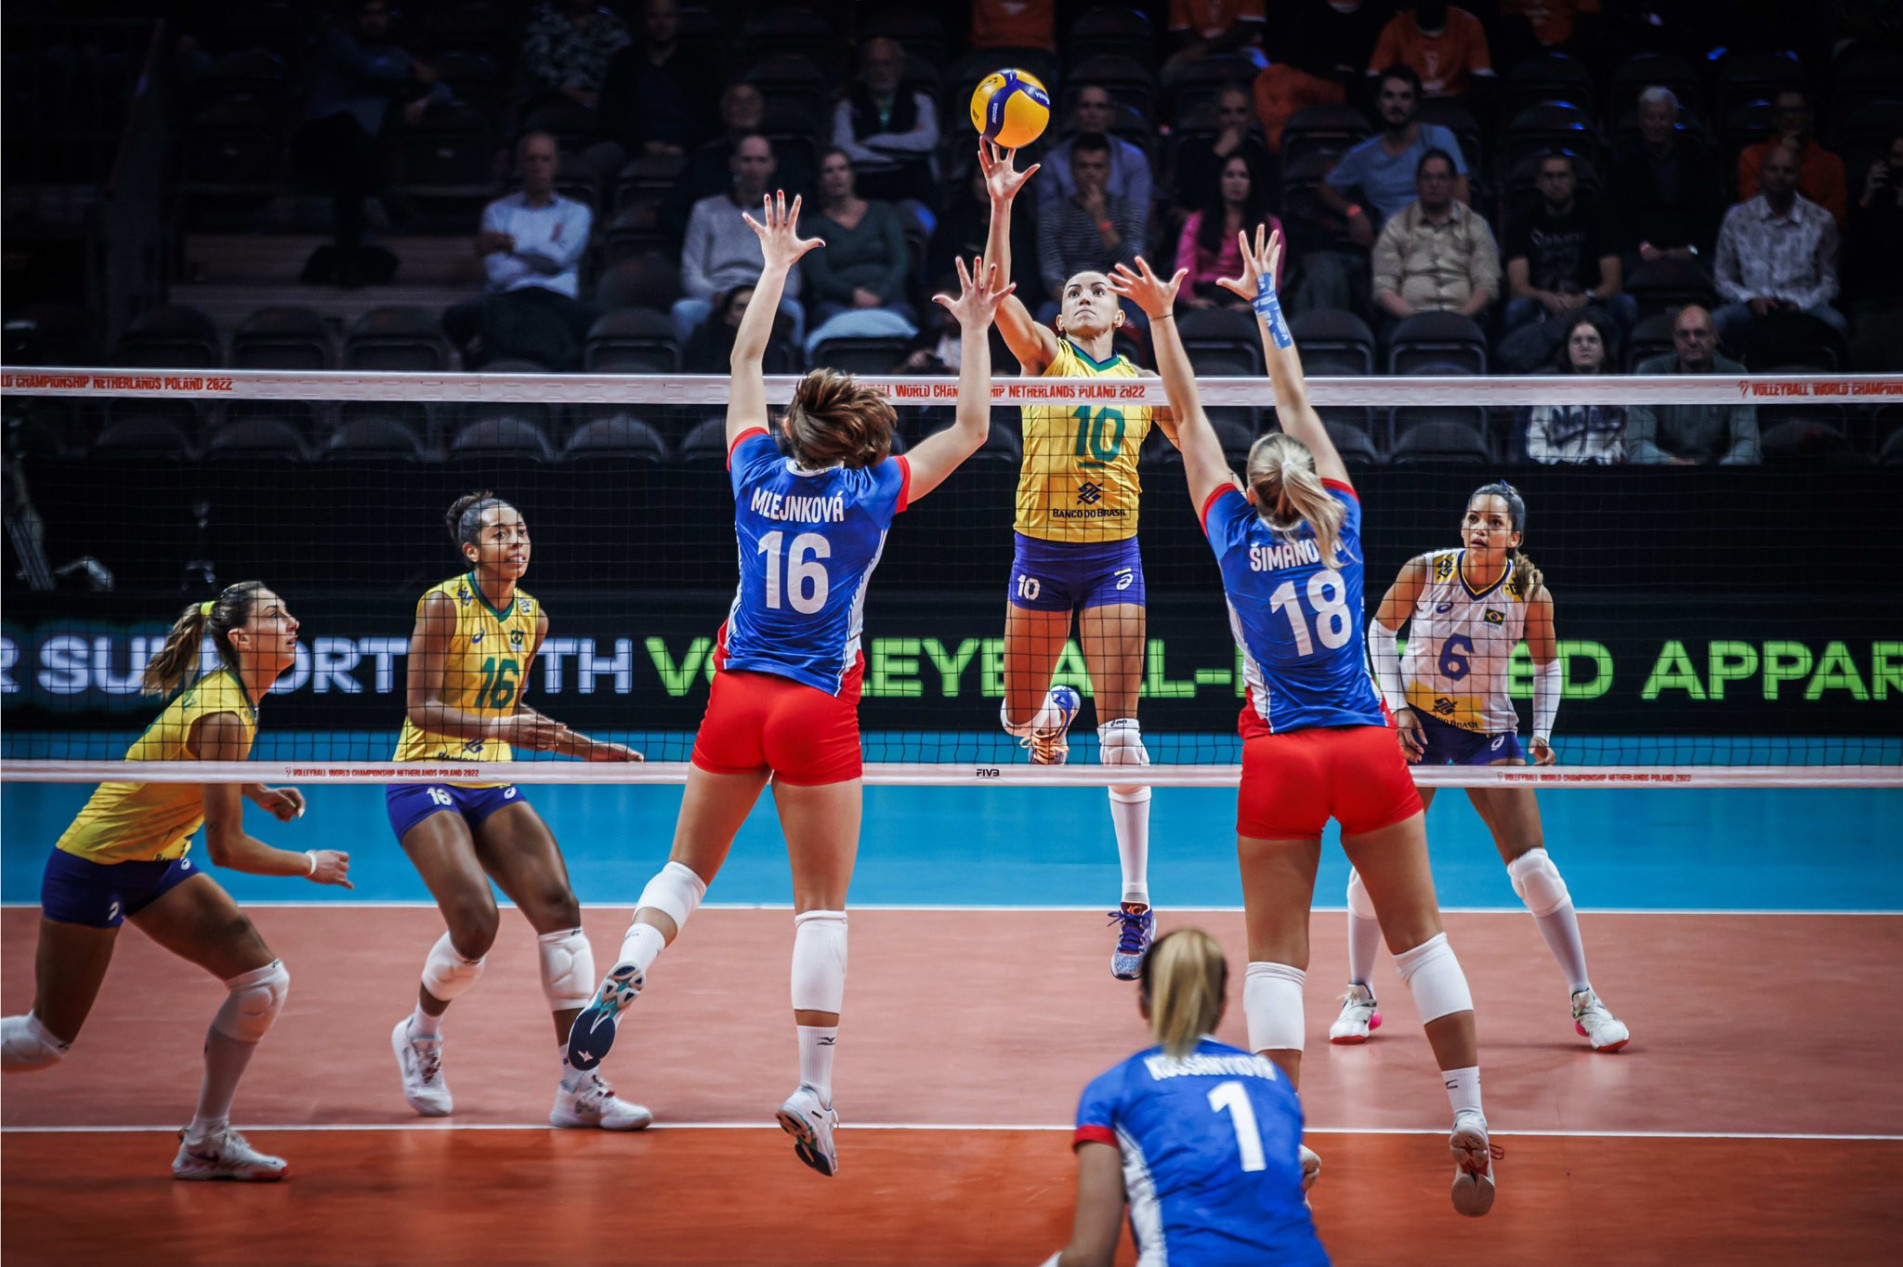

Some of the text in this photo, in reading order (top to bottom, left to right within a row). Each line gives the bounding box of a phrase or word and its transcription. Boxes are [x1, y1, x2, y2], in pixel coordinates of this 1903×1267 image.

[16, 375, 89, 388] CHAMPIONSHIP
[93, 376, 161, 390] NETHERLANDS
[165, 377, 203, 390] POLAND
[206, 377, 232, 391] 2022
[895, 384, 930, 398] WORLD
[1008, 384, 1075, 398] NETHERLANDS
[1079, 384, 1116, 398] POLAND
[1119, 384, 1145, 398] 2022
[1752, 382, 1809, 396] VOLLEYBALL
[1813, 382, 1848, 396] WORLD
[1070, 406, 1125, 463] 10
[751, 487, 845, 523] MLEJNKOVÁ
[1052, 508, 1083, 518] BANCO
[1085, 509, 1096, 518] DO
[758, 531, 831, 614] 16
[1017, 574, 1041, 600] 10
[1269, 570, 1352, 657] 18
[1438, 633, 1475, 682] 6
[474, 656, 519, 709] 16
[976, 768, 1000, 777] FIVB
[427, 787, 452, 805] 16
[1206, 1080, 1267, 1173] 1
